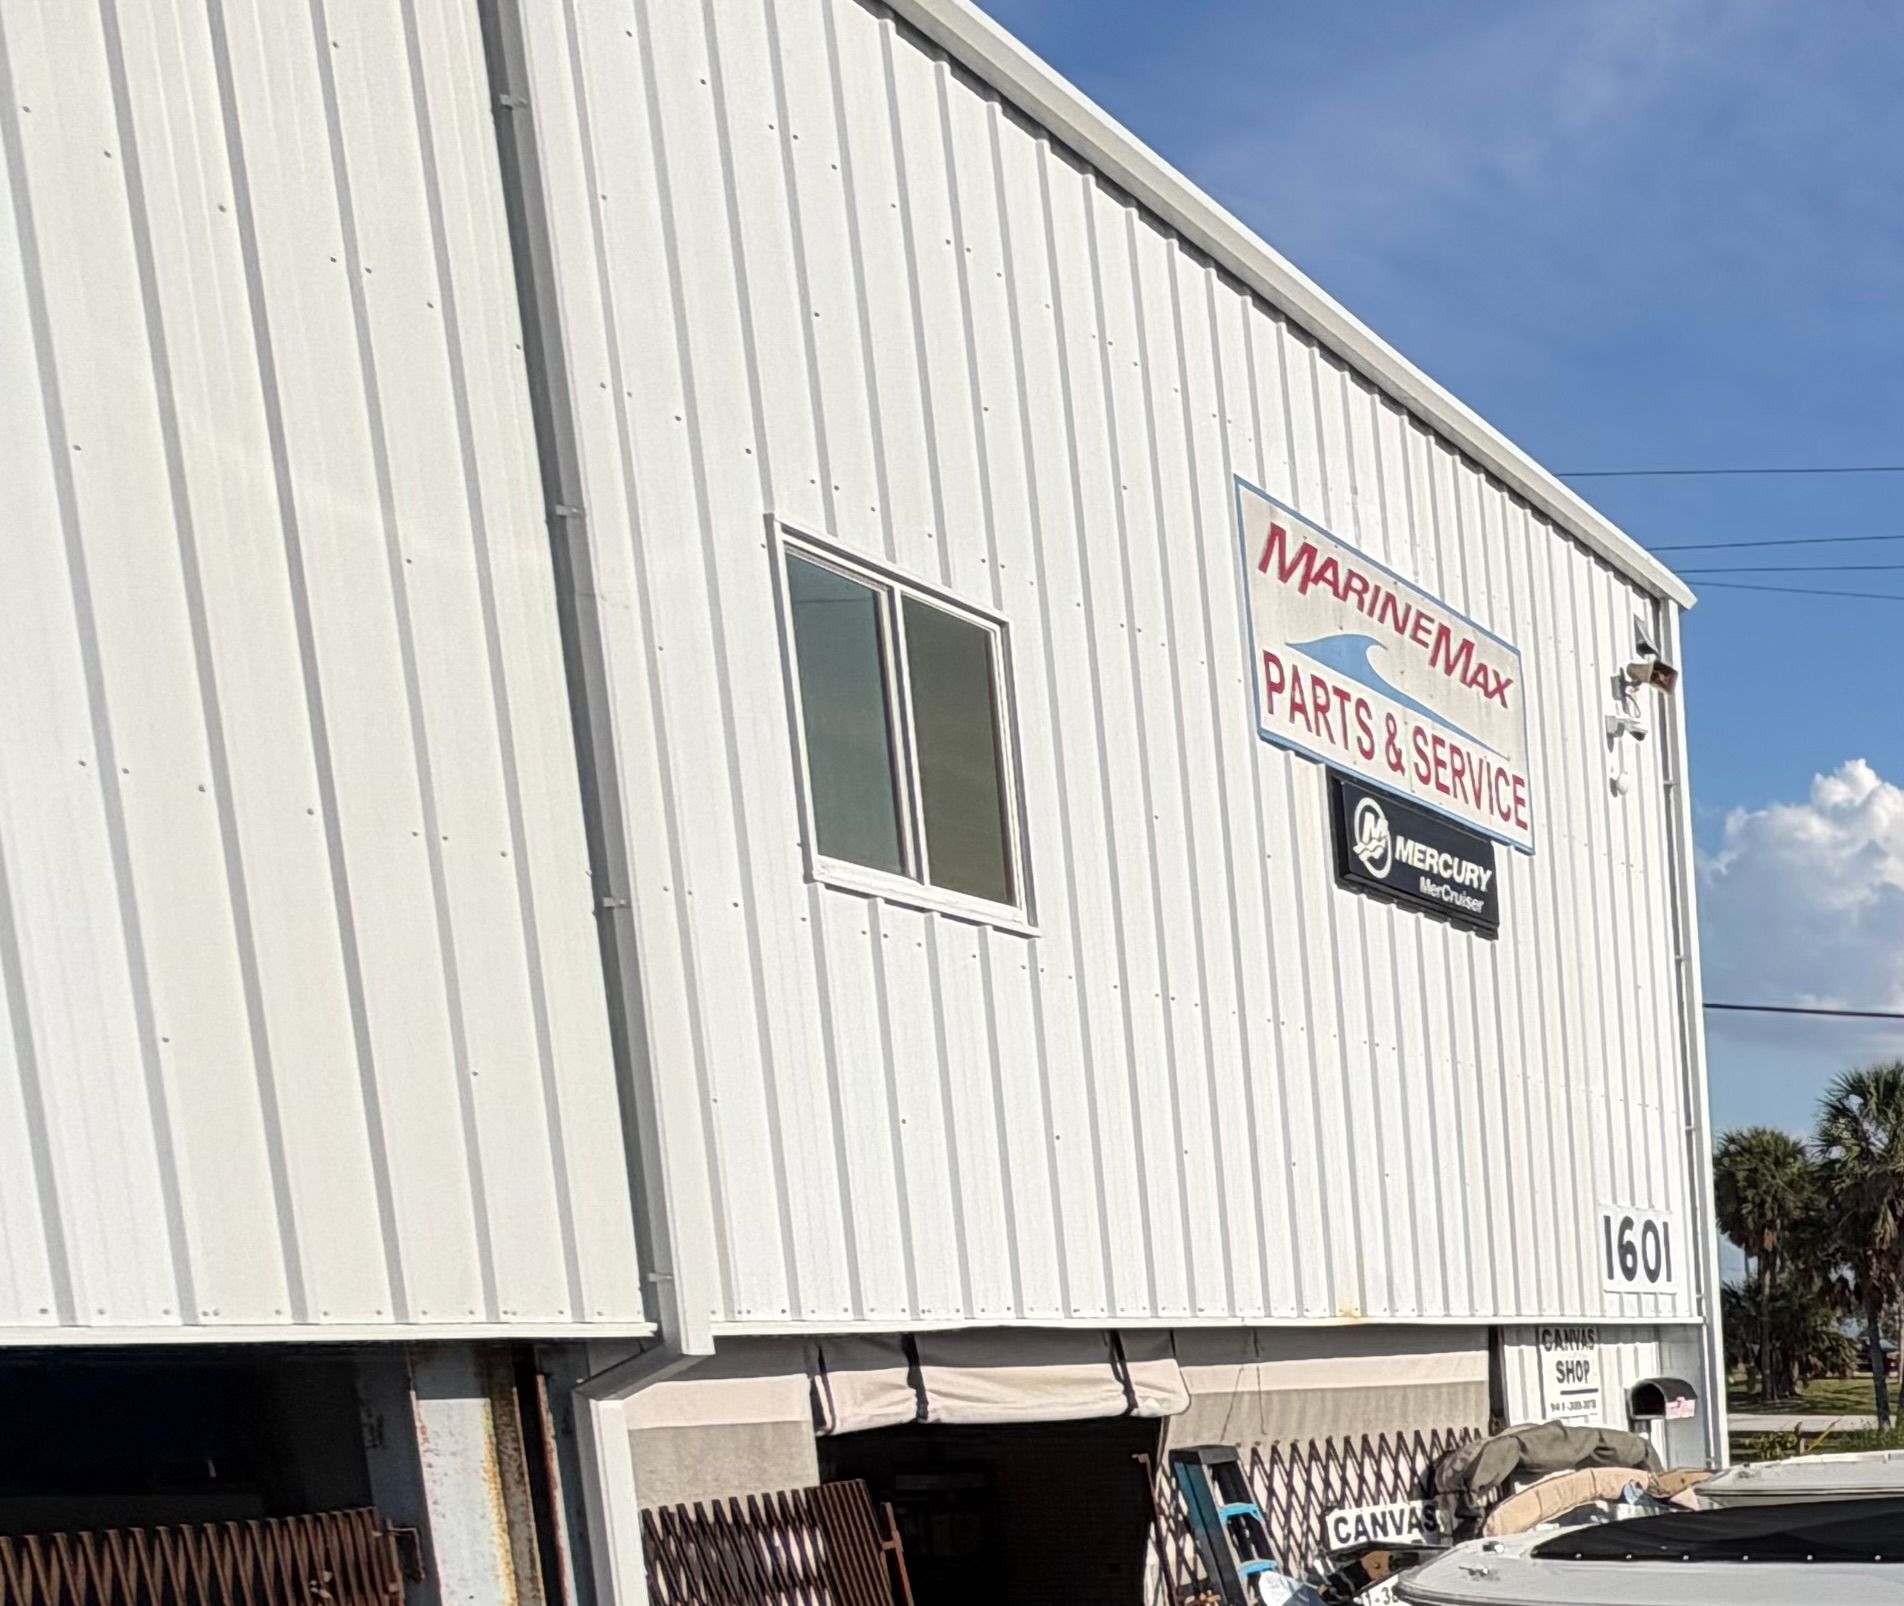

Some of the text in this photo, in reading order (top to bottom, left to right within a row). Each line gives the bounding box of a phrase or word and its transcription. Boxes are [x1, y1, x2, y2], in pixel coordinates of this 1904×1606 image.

[1262, 649, 1529, 831] PARTS & SERVICE
[1395, 835, 1492, 892] MERCURY
[1419, 876, 1484, 913] MerCruiser
[1603, 1215, 1672, 1284] 1601
[1542, 1328, 1595, 1352] CANVAS
[1556, 1360, 1590, 1384] SHOP
[1333, 1504, 1438, 1544] CANVAS
